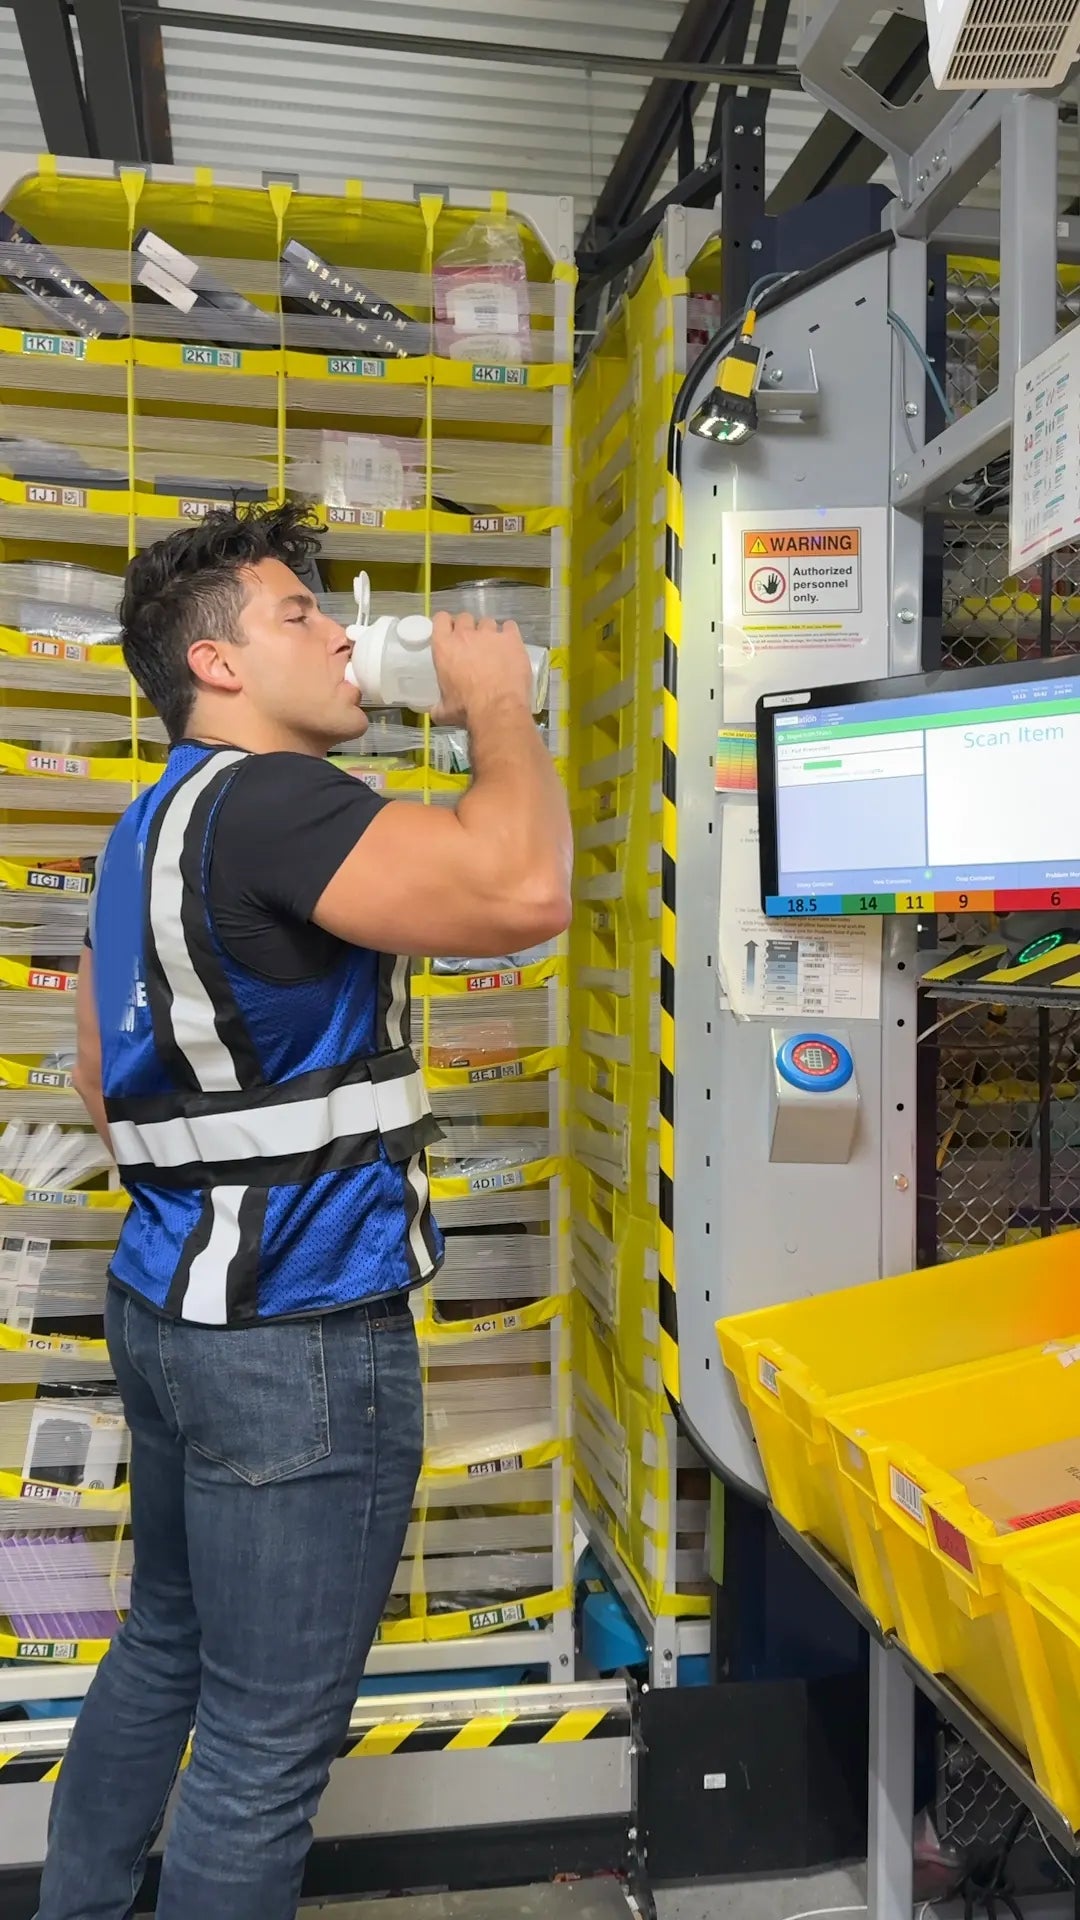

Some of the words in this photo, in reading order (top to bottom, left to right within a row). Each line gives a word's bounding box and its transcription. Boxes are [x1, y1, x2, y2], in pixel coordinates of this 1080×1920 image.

[306, 259, 367, 304] HAVEN
[308, 290, 367, 333] HAVEN
[371, 304, 407, 331] NUT
[769, 535, 852, 552] WARNING
[793, 566, 853, 577] Authorized
[793, 580, 848, 591] personnel
[793, 593, 820, 604] only.
[964, 731, 1010, 749] Scan
[1019, 726, 1064, 743] Item
[788, 898, 817, 912] 18.5
[859, 897, 878, 911] 14
[905, 896, 924, 909] 11
[959, 894, 968, 908] 9
[1051, 891, 1061, 906] 6
